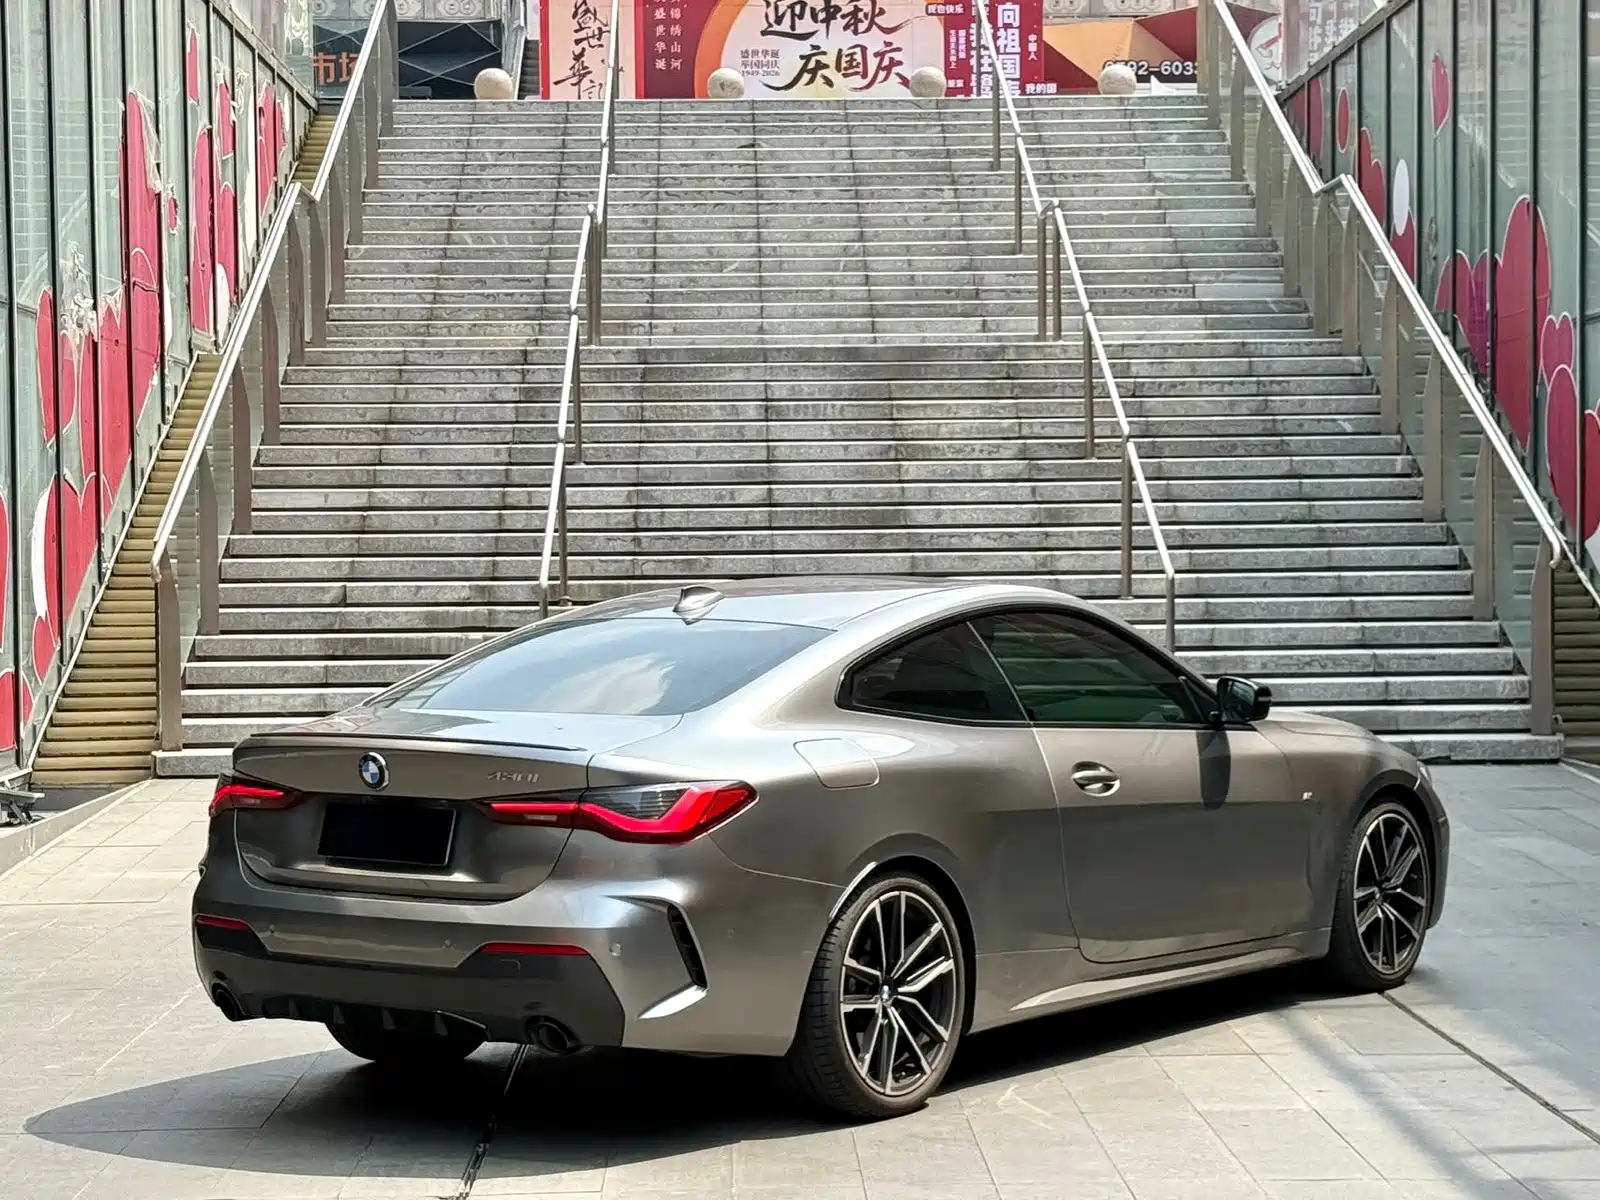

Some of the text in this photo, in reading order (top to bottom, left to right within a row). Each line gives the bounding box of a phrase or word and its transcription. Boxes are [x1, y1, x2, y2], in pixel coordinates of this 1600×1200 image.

[654, 0, 667, 70] 盛世华诞
[669, 0, 682, 70] 锦绣山河
[760, 0, 925, 41] 迎中秋
[759, 40, 911, 92] 庆国庆
